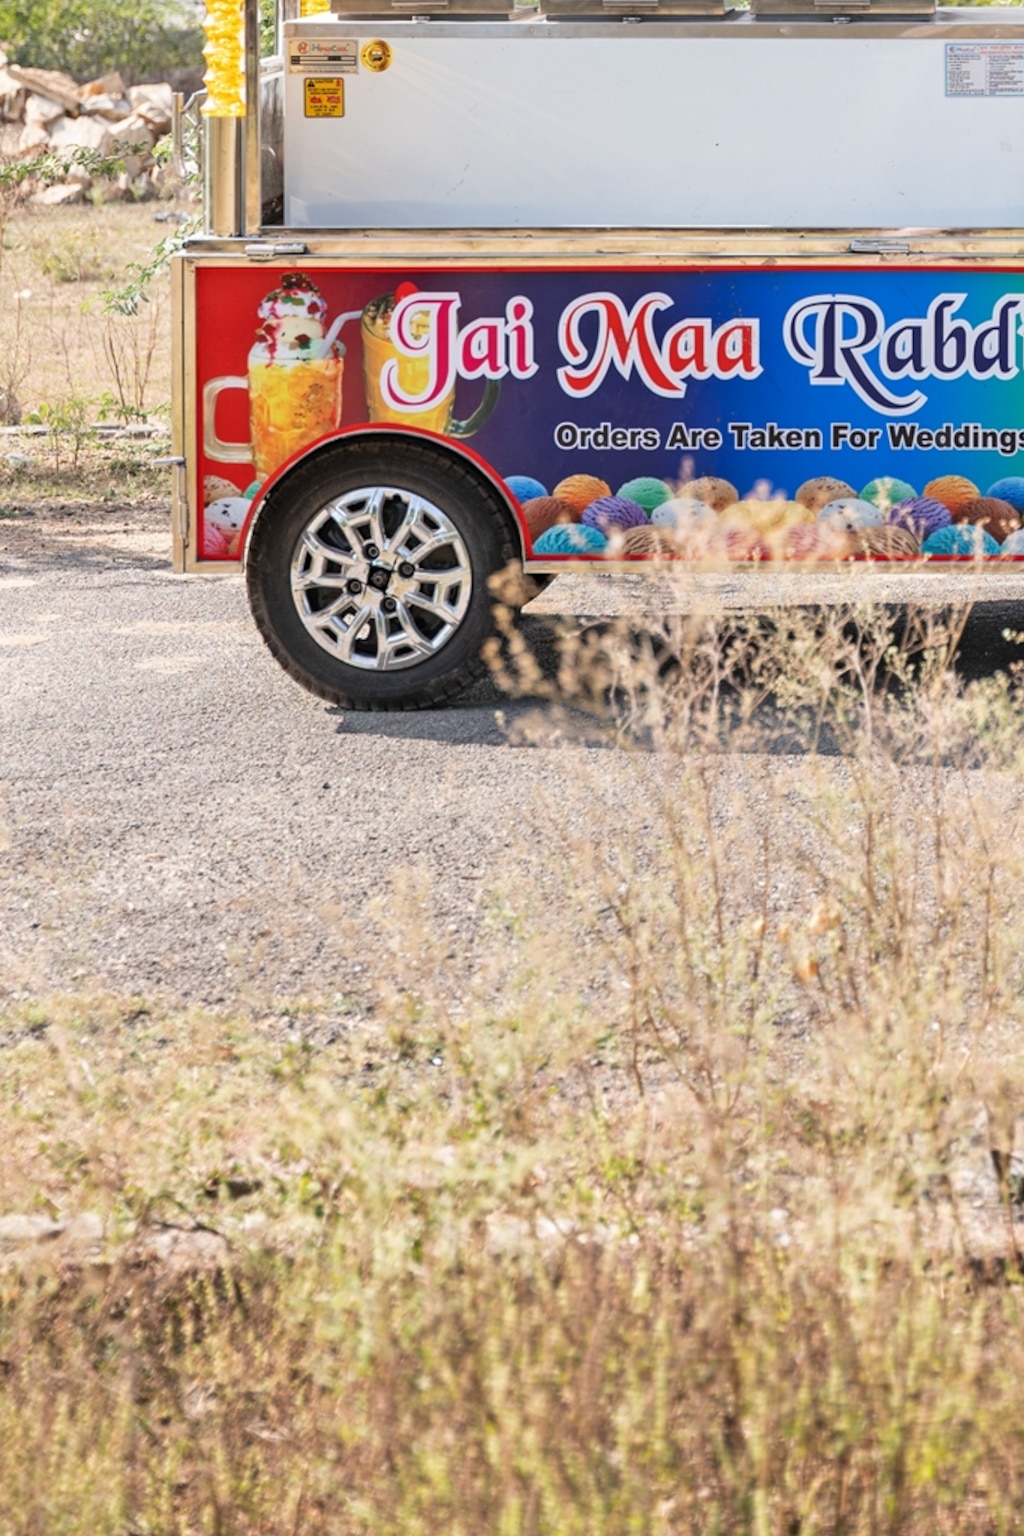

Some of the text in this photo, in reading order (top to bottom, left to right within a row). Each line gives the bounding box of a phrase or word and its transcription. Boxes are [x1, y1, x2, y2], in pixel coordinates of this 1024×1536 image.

[381, 292, 539, 413] Jai
[557, 292, 763, 398] Maa
[555, 422, 660, 450] Orders
[666, 422, 722, 450] Are
[728, 422, 823, 450] Taken
[831, 423, 882, 450] For
